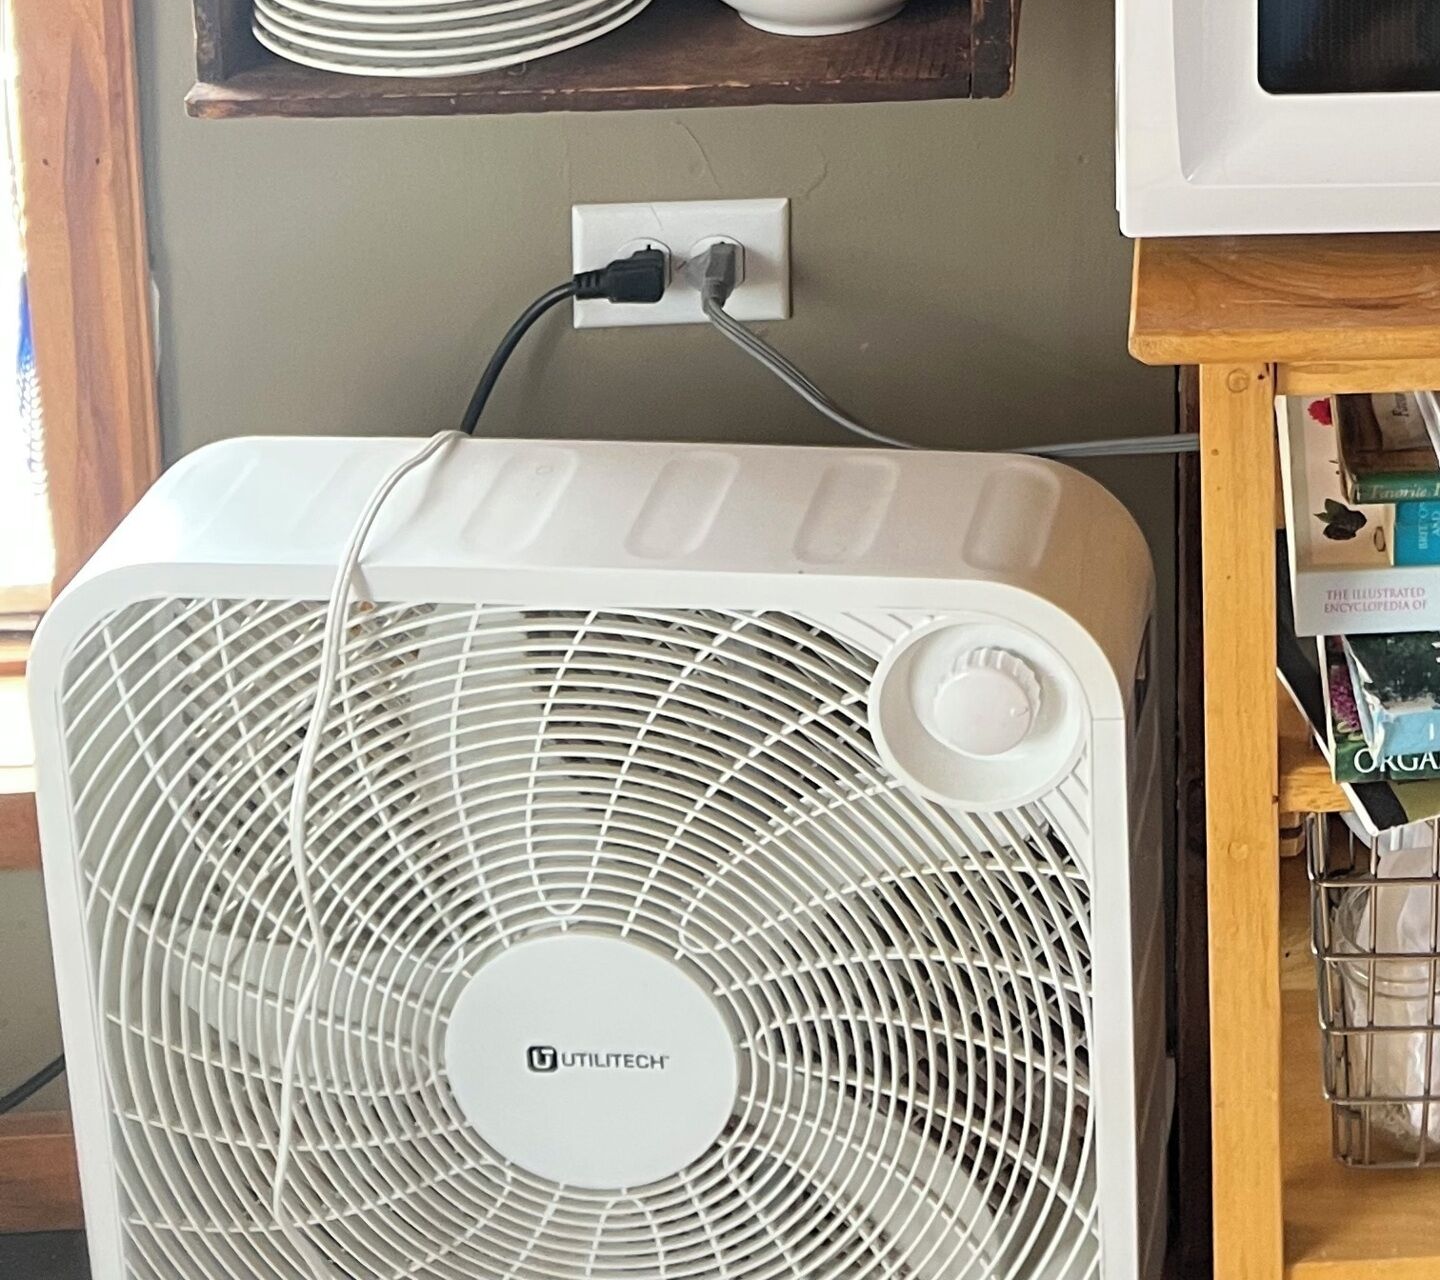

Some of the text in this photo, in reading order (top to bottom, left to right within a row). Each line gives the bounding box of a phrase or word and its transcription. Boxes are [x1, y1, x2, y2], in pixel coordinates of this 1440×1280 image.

[1370, 484, 1427, 499] Favorite
[1326, 587, 1426, 601] THE ILLUSTRATED
[1324, 600, 1428, 614] ENCYCLOPEDIA OF
[561, 1053, 665, 1070] UTILITECH
